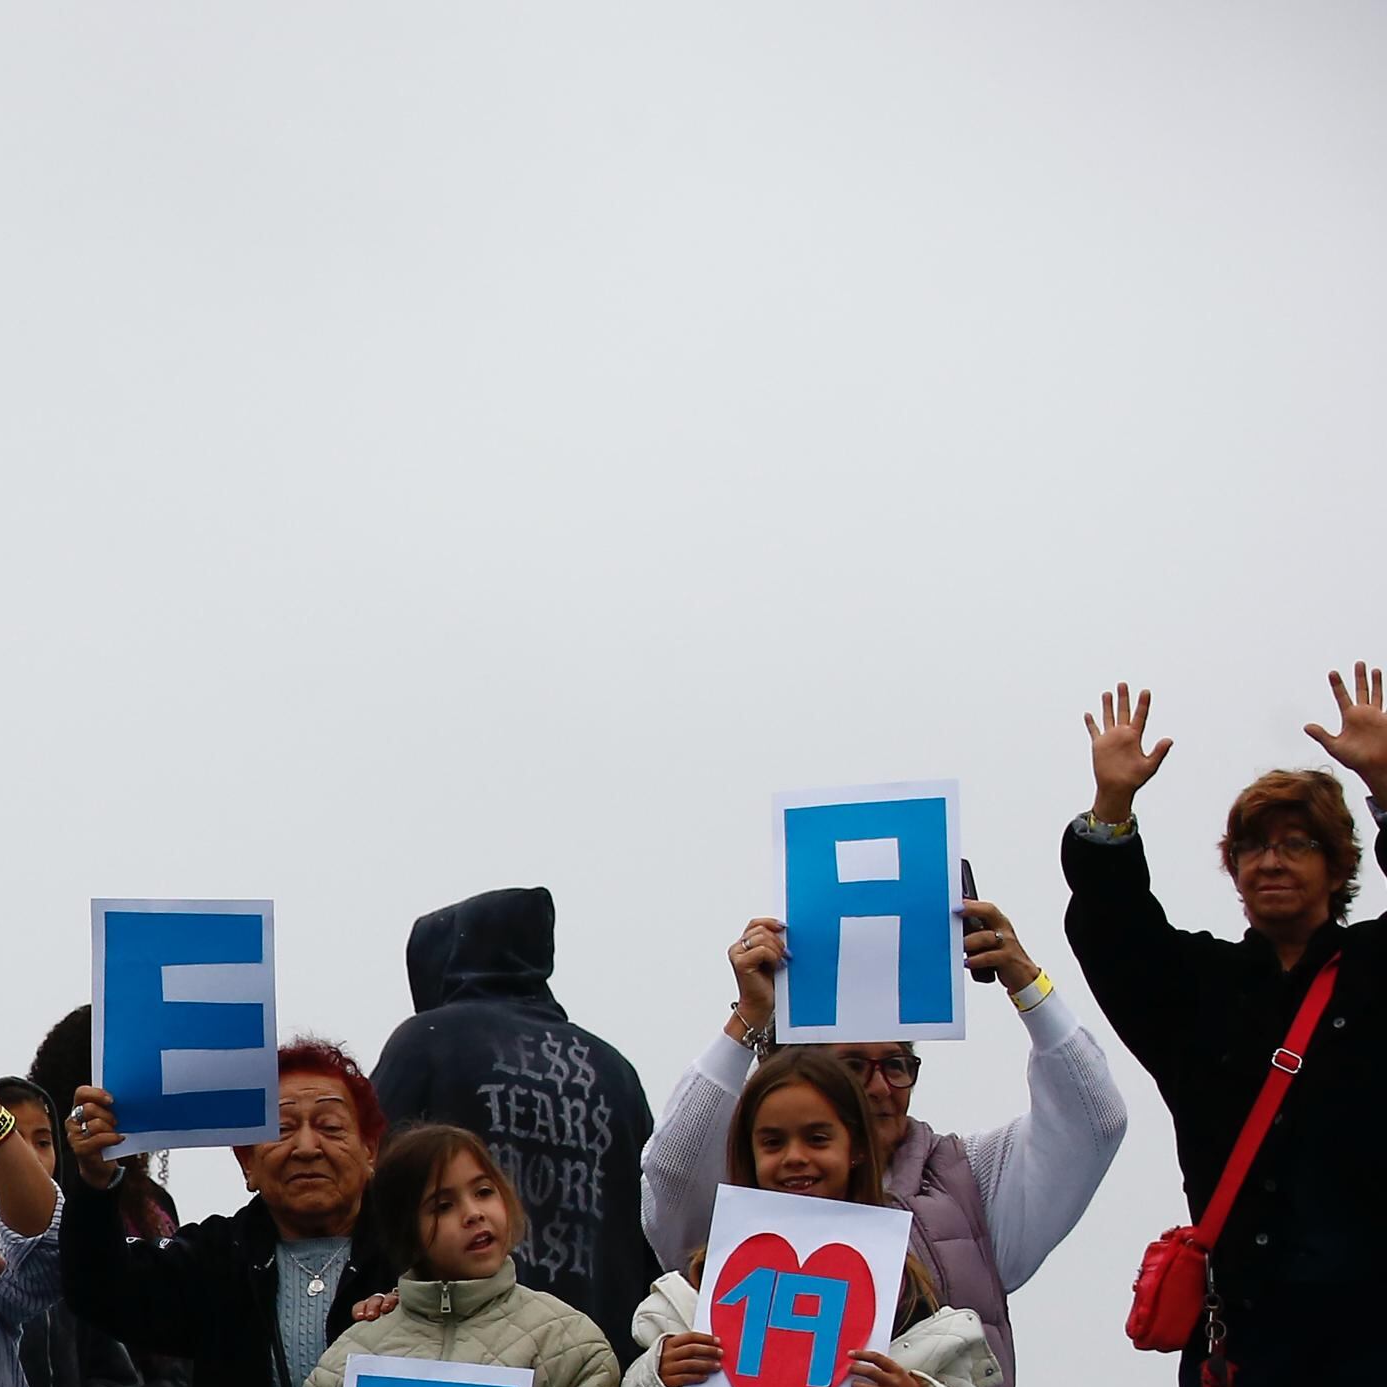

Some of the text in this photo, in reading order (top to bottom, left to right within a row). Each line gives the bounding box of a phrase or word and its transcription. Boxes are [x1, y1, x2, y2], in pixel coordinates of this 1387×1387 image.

[785, 796, 955, 1028] A
[103, 911, 267, 1133] E
[477, 1083, 613, 1162] TEAR$
[514, 1210, 595, 1283] A$H
[716, 1267, 849, 1387] 19
